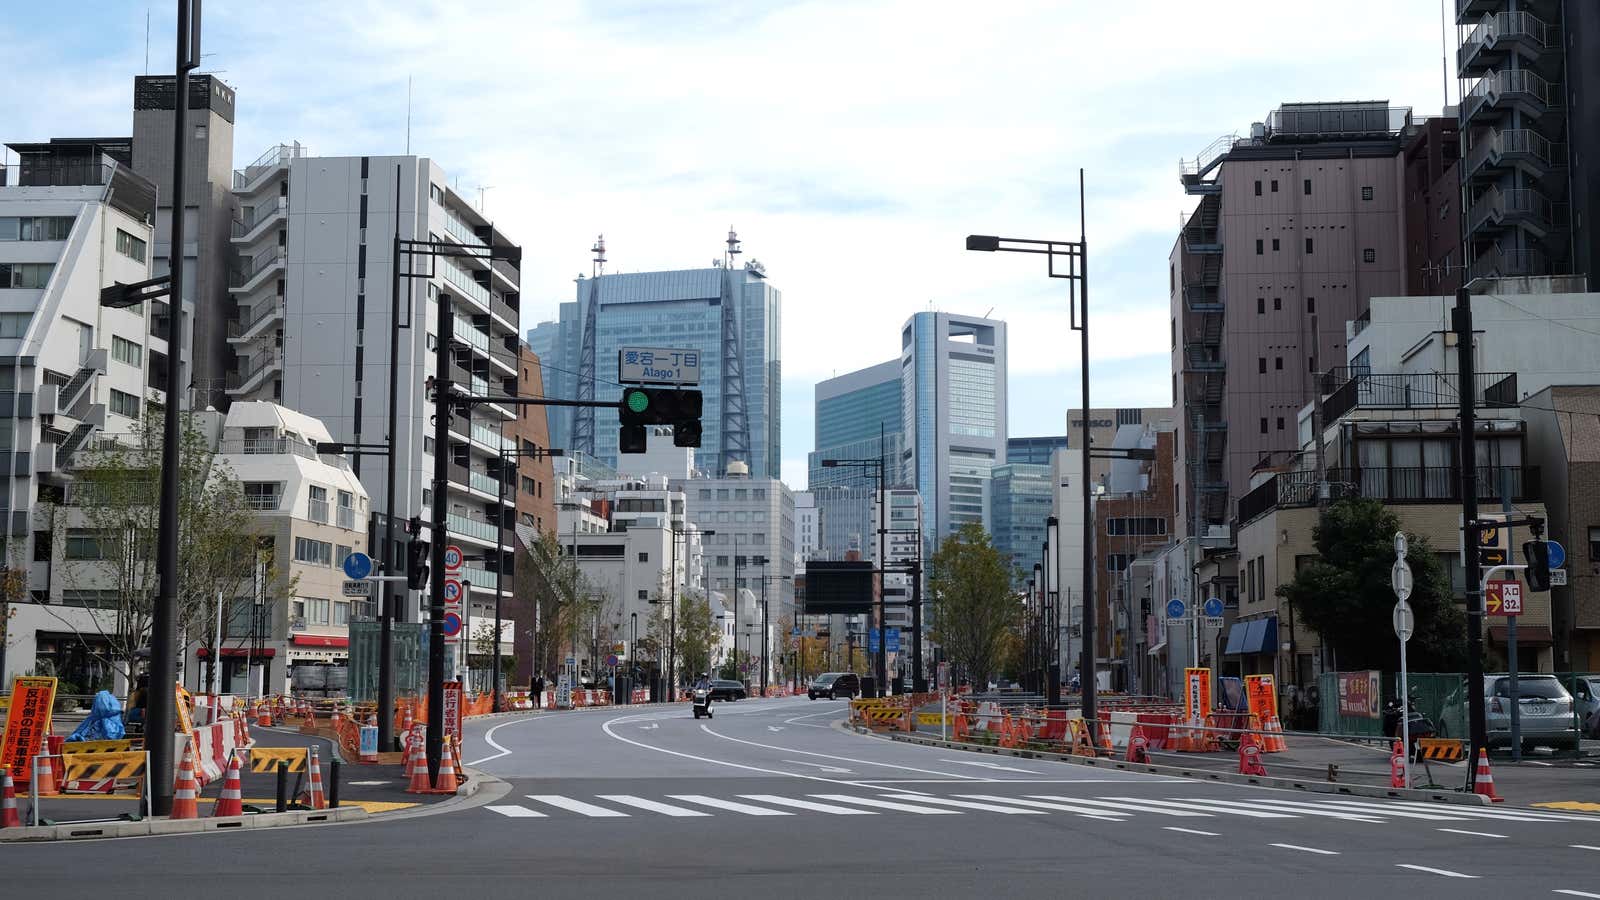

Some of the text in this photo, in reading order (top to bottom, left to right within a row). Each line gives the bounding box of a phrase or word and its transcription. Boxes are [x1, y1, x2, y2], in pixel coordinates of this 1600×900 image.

[625, 351, 697, 367] 愛宕一丁目
[643, 368, 680, 379] Atago 1
[1071, 419, 1113, 428] TRSCO
[446, 553, 458, 564] 40
[1504, 587, 1519, 596] 入口
[12, 688, 40, 776] 反対側の自転車道を
